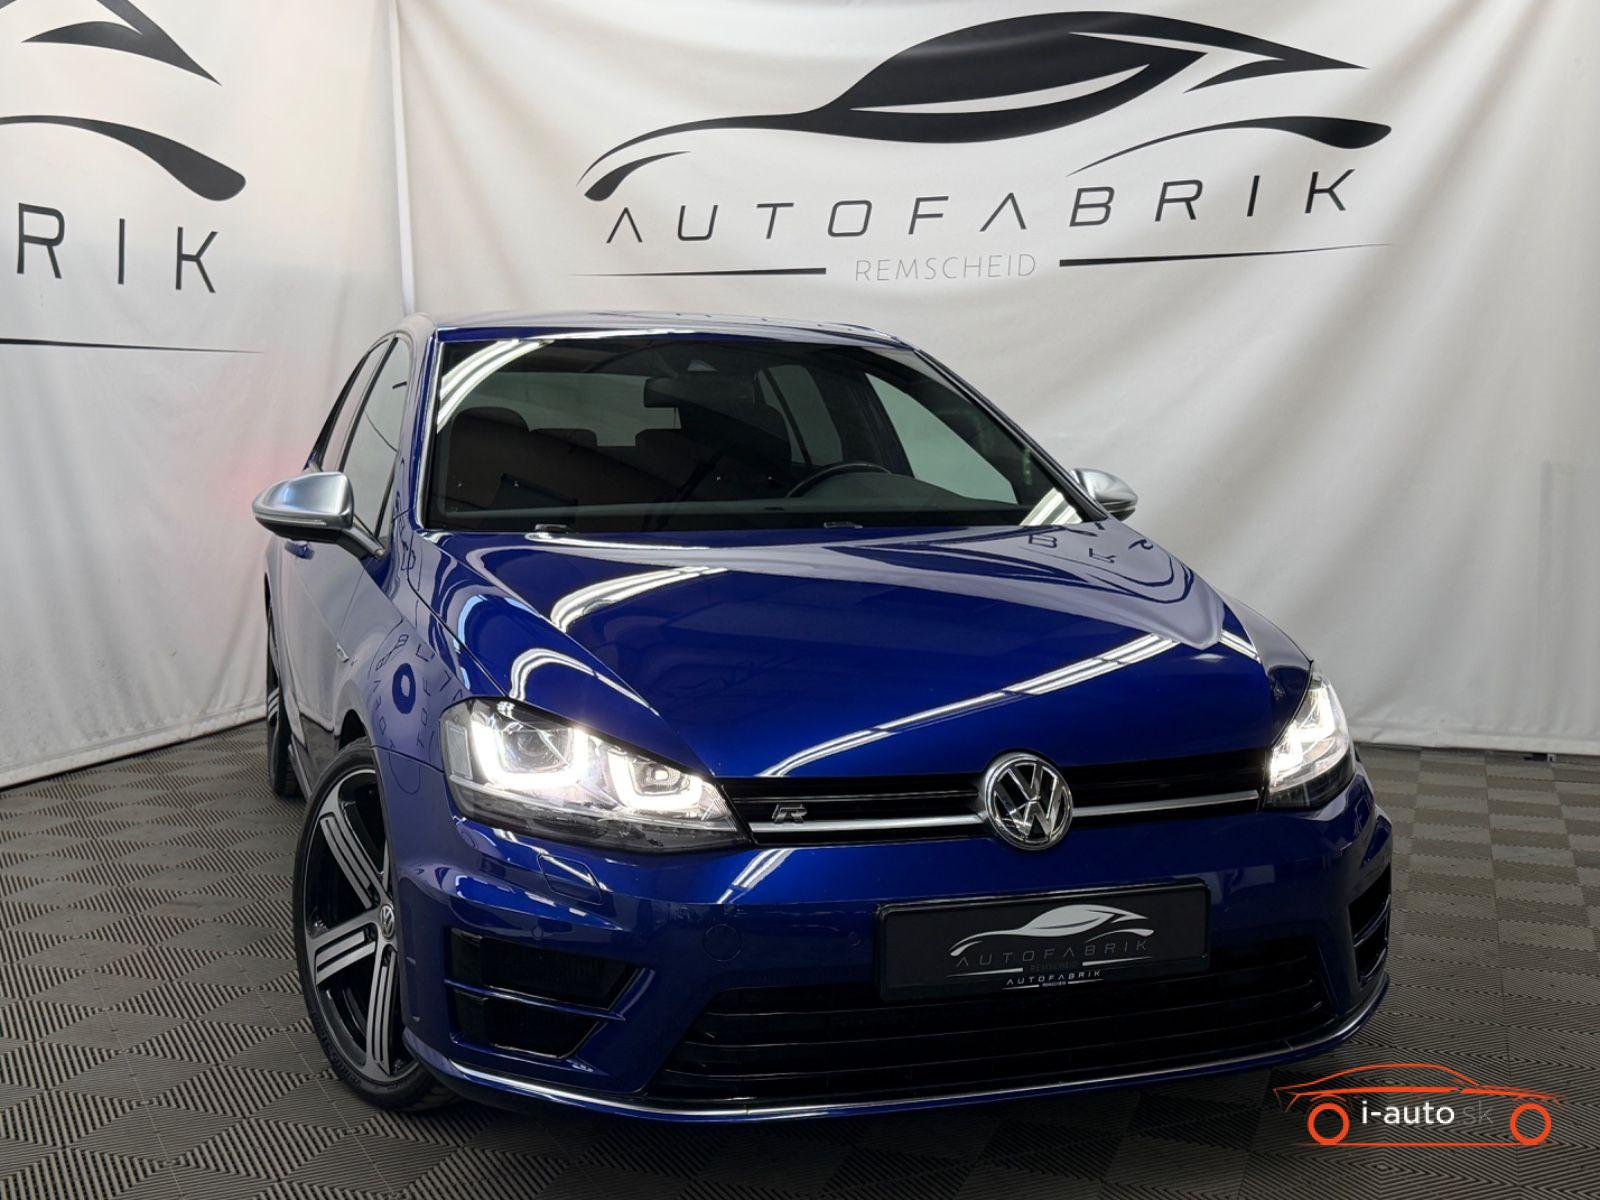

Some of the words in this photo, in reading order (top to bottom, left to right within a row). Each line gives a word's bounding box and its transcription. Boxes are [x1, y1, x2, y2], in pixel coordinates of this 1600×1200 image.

[605, 168, 1355, 244] AUTOFABRIK
[17, 202, 218, 293] RIK
[855, 253, 1036, 281] REMSCHEID
[955, 939, 1148, 968] AUTOFABRIK
[1005, 969, 1102, 986] AUTOFABRIK
